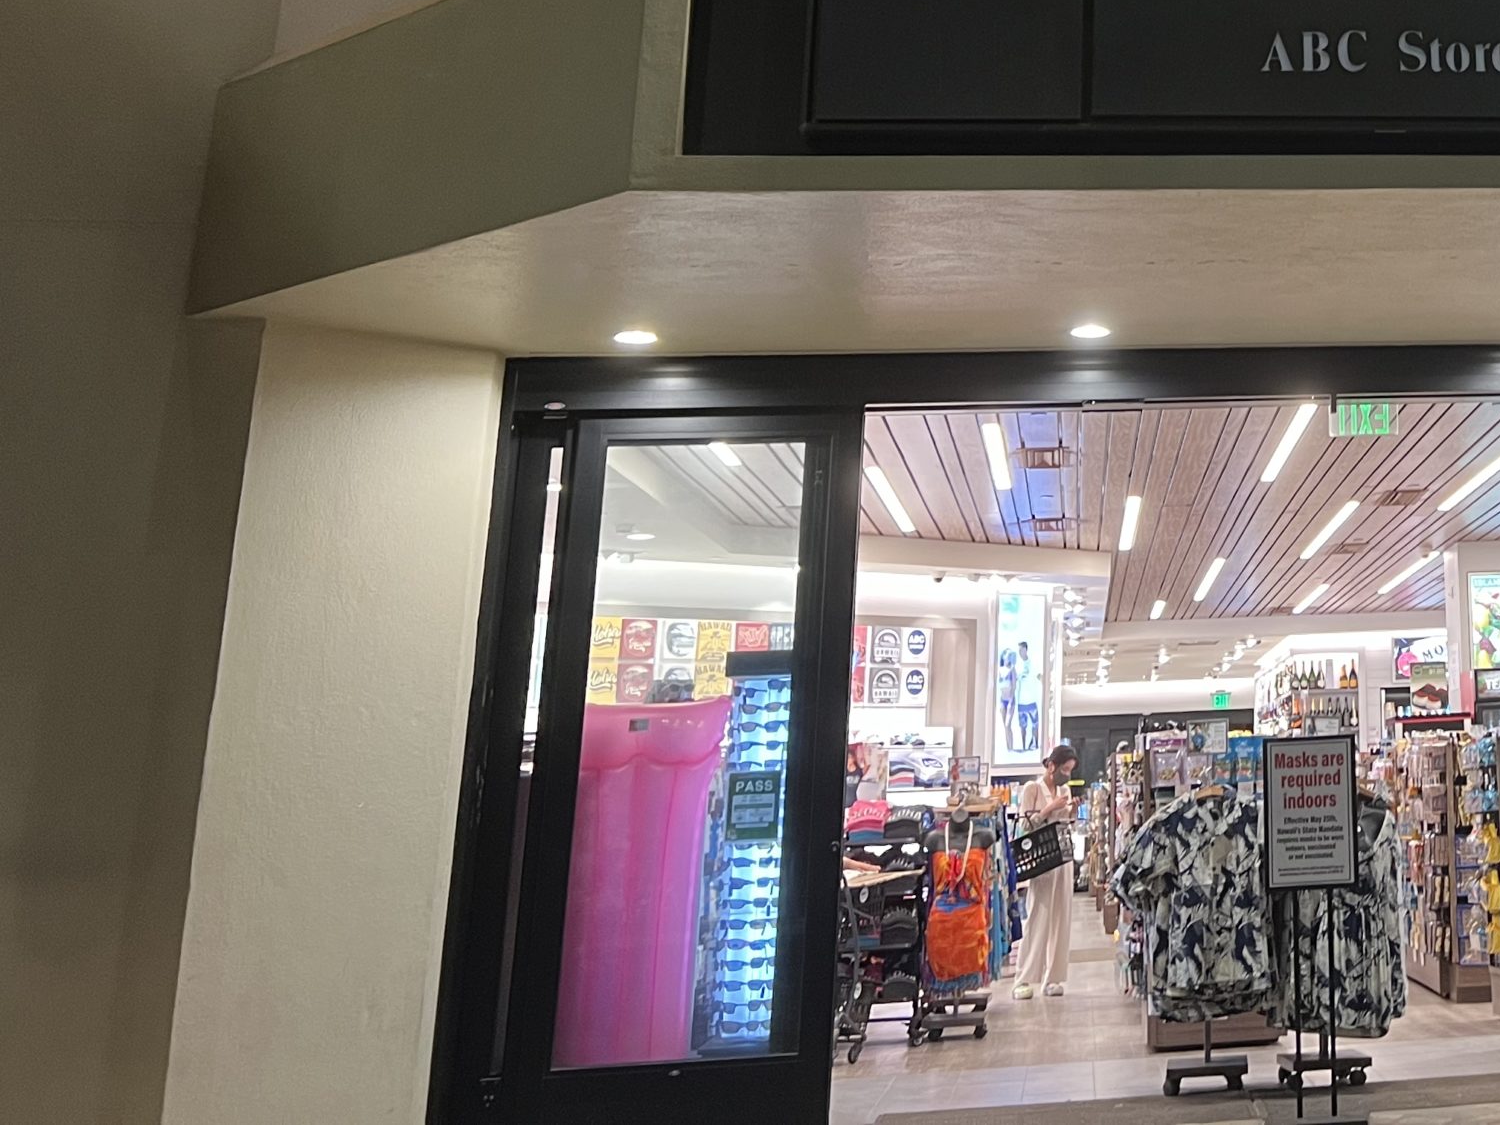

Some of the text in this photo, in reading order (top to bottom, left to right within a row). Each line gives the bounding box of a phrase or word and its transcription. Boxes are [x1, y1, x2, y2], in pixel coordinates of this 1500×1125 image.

[1260, 29, 1368, 73] ABC
[1274, 751, 1344, 769] Masks are
[735, 779, 774, 793] PASS
[1281, 769, 1341, 792] required
[1283, 793, 1337, 809] indoors
